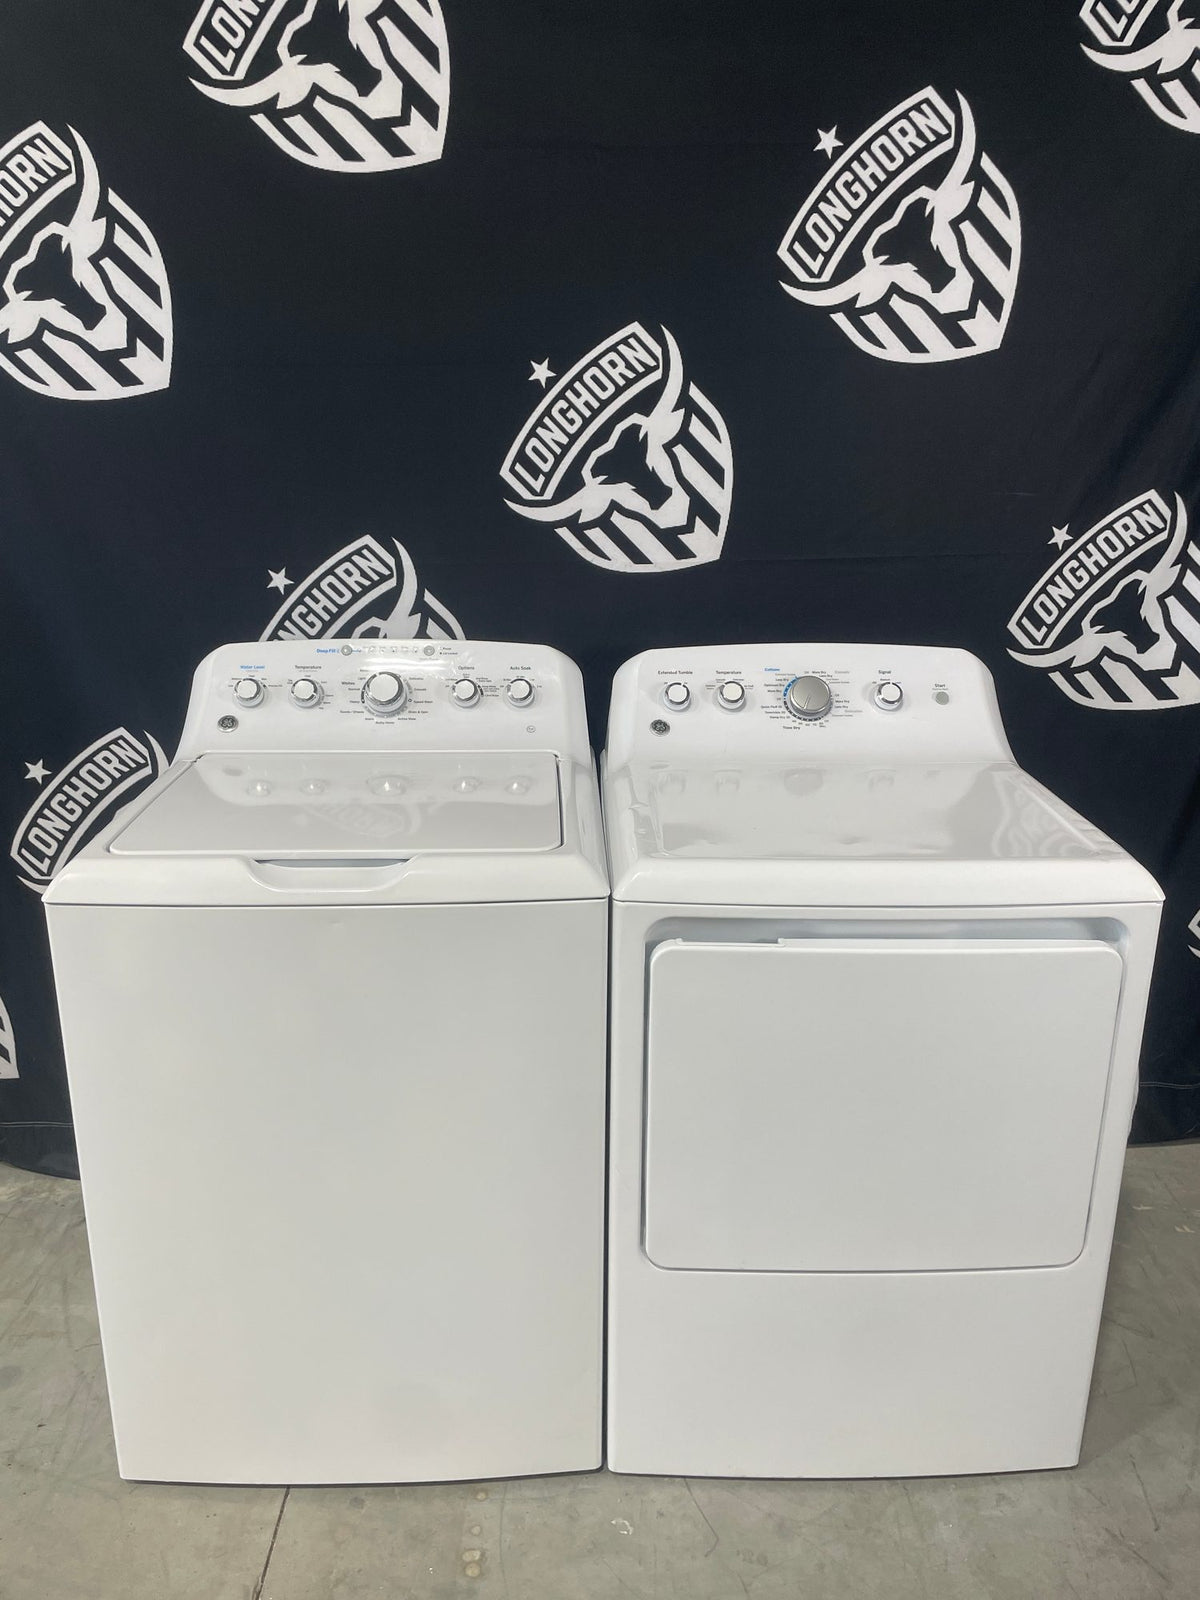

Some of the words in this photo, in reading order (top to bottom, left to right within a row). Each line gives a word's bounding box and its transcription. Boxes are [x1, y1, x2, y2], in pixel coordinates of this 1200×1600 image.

[200, 0, 268, 72] LON
[792, 103, 949, 275] LONGHORN
[514, 336, 657, 493] LONGHORN
[272, 548, 392, 641] NGHORN
[1021, 503, 1165, 643] LONGHORN
[20, 739, 147, 874] LONGHORN
